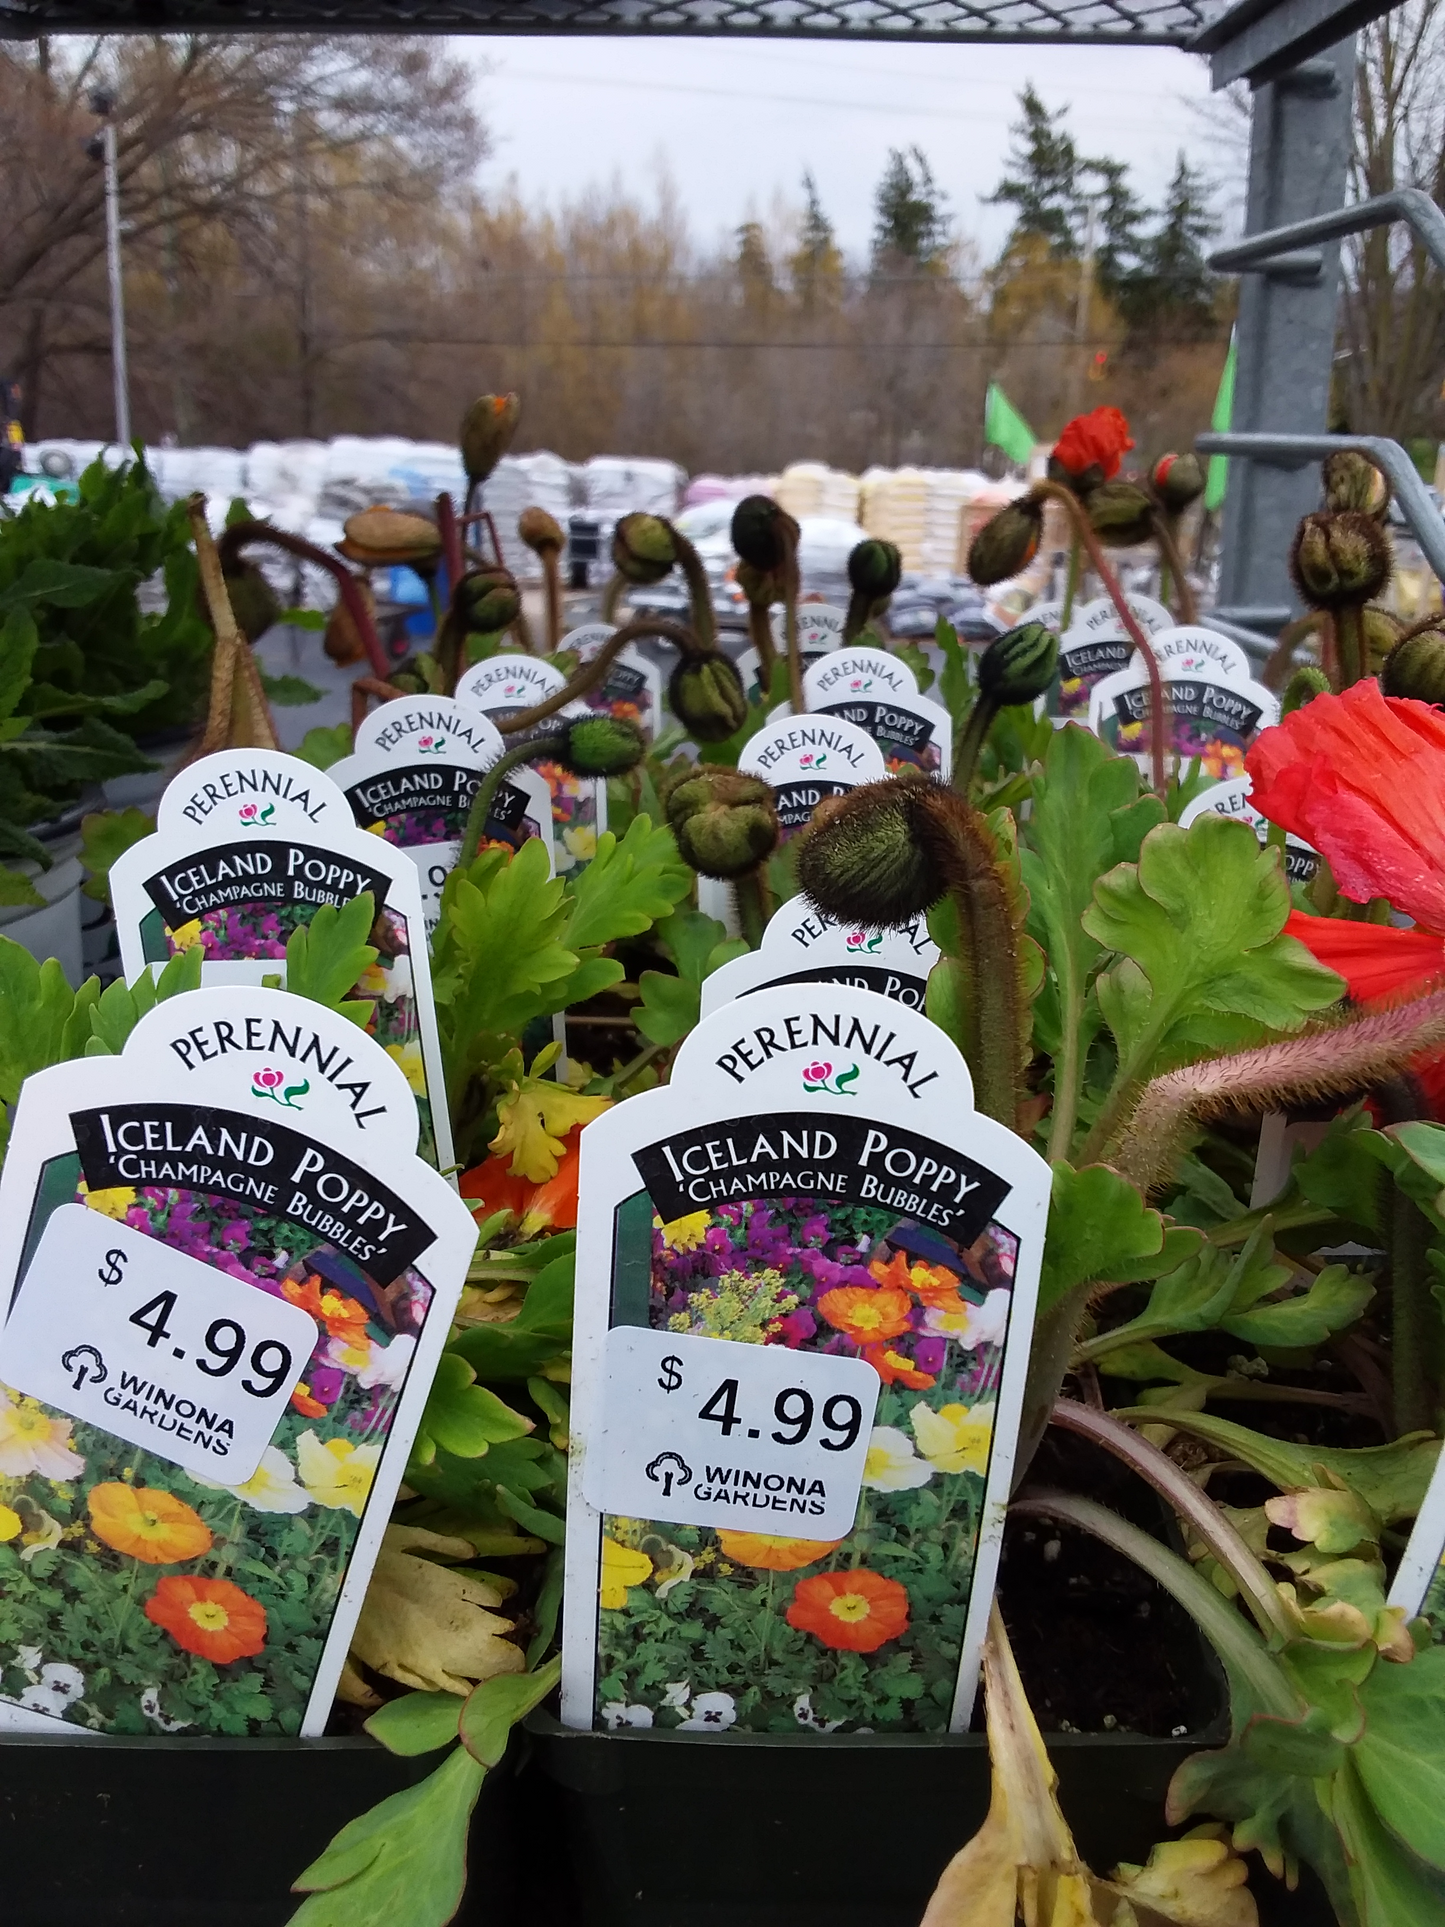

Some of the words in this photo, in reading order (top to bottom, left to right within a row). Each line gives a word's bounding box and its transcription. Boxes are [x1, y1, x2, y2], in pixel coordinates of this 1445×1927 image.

[816, 659, 905, 692] PERENNIAL
[1065, 646, 1127, 668] ICELAND
[874, 705, 925, 737] POPPY
[1202, 686, 1253, 720] POPPY
[374, 711, 487, 754] PERENNIAL
[757, 728, 865, 770] PERENNIAL
[182, 768, 328, 825] PERENNIAL
[354, 772, 443, 808] ICELAND
[367, 795, 452, 819] 'CHAMPAGNE
[160, 852, 273, 901] ICELAND
[286, 848, 372, 895] POPPY
[176, 882, 285, 915] 'CHAMPAGNE
[791, 912, 932, 956] PERAL
[169, 1017, 388, 1129] PERENNIAL
[715, 1013, 940, 1099] PERENNIAL
[100, 1114, 275, 1167] ICELAND
[290, 1147, 408, 1241] POPPY
[661, 1130, 838, 1182] ICELAND
[857, 1129, 981, 1204] POPPY
[109, 1154, 279, 1206] 'CHAMPAGNE
[285, 1191, 388, 1263] BUBBLES'
[678, 1170, 849, 1203] 'CHAMPAGNE
[859, 1174, 966, 1228] BUBBLES'
[98, 1248, 129, 1288] $
[128, 1289, 292, 1399] 4.99
[103, 1386, 231, 1457] GARDENS
[119, 1370, 235, 1440] WINONA
[657, 1354, 685, 1395] $
[698, 1378, 863, 1452] 4.99
[693, 1483, 826, 1517] GARDENS
[705, 1464, 827, 1498] WINONA
